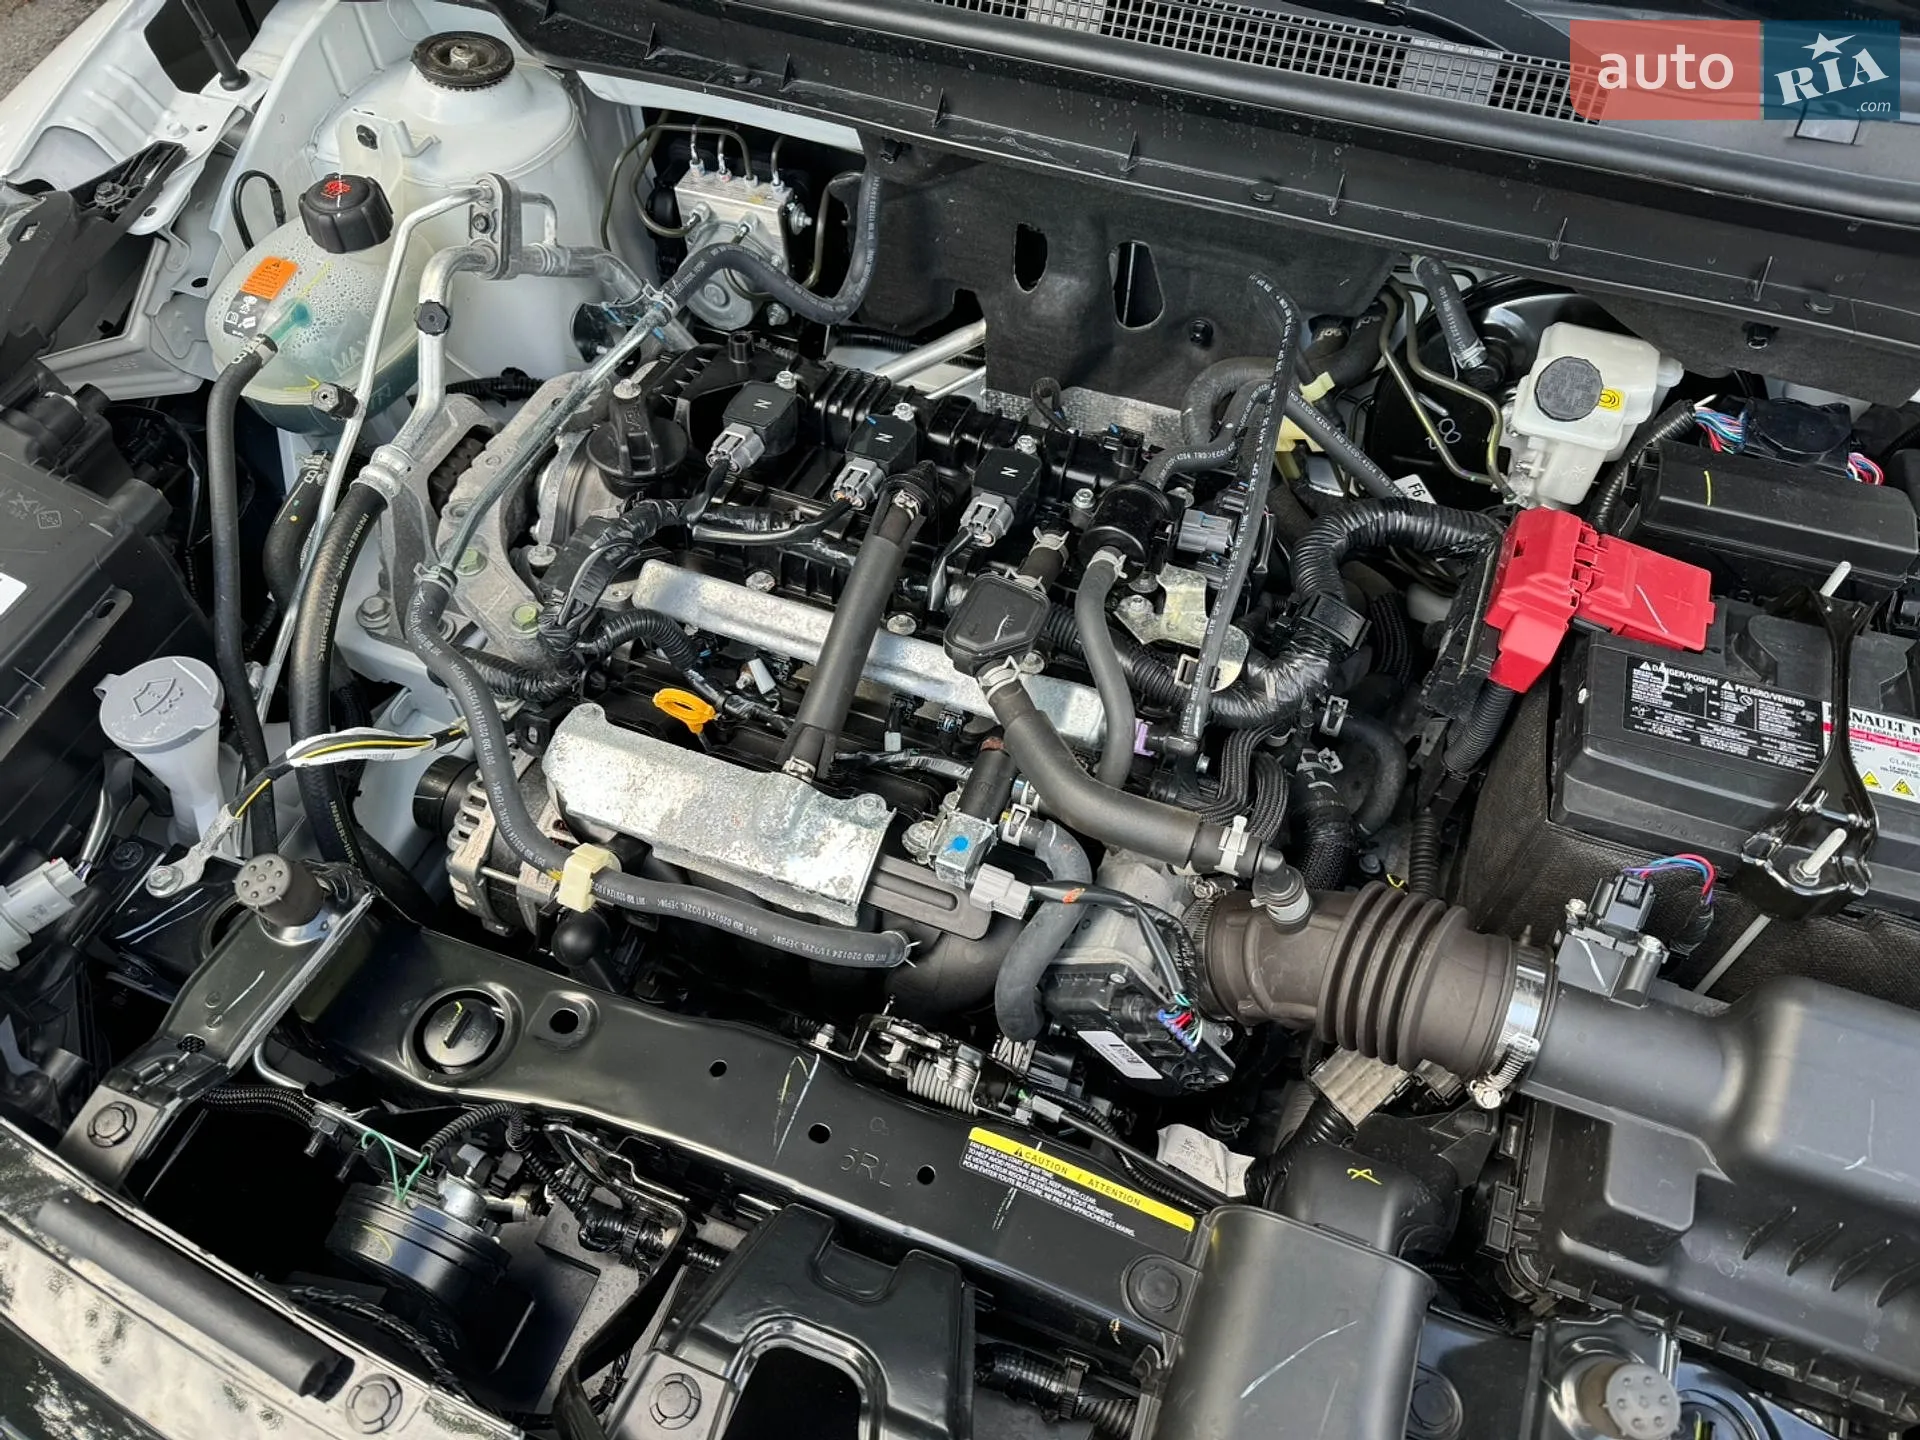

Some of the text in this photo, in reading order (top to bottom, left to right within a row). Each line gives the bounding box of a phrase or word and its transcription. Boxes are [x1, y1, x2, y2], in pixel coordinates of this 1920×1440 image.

[1407, 482, 1426, 498] F6
[1651, 663, 1718, 686] DANGER/POISON
[1735, 684, 1805, 708] PELIGRO/VENENO
[1023, 1150, 1069, 1175] CAUTION
[1086, 1178, 1142, 1207] ATTENTION
